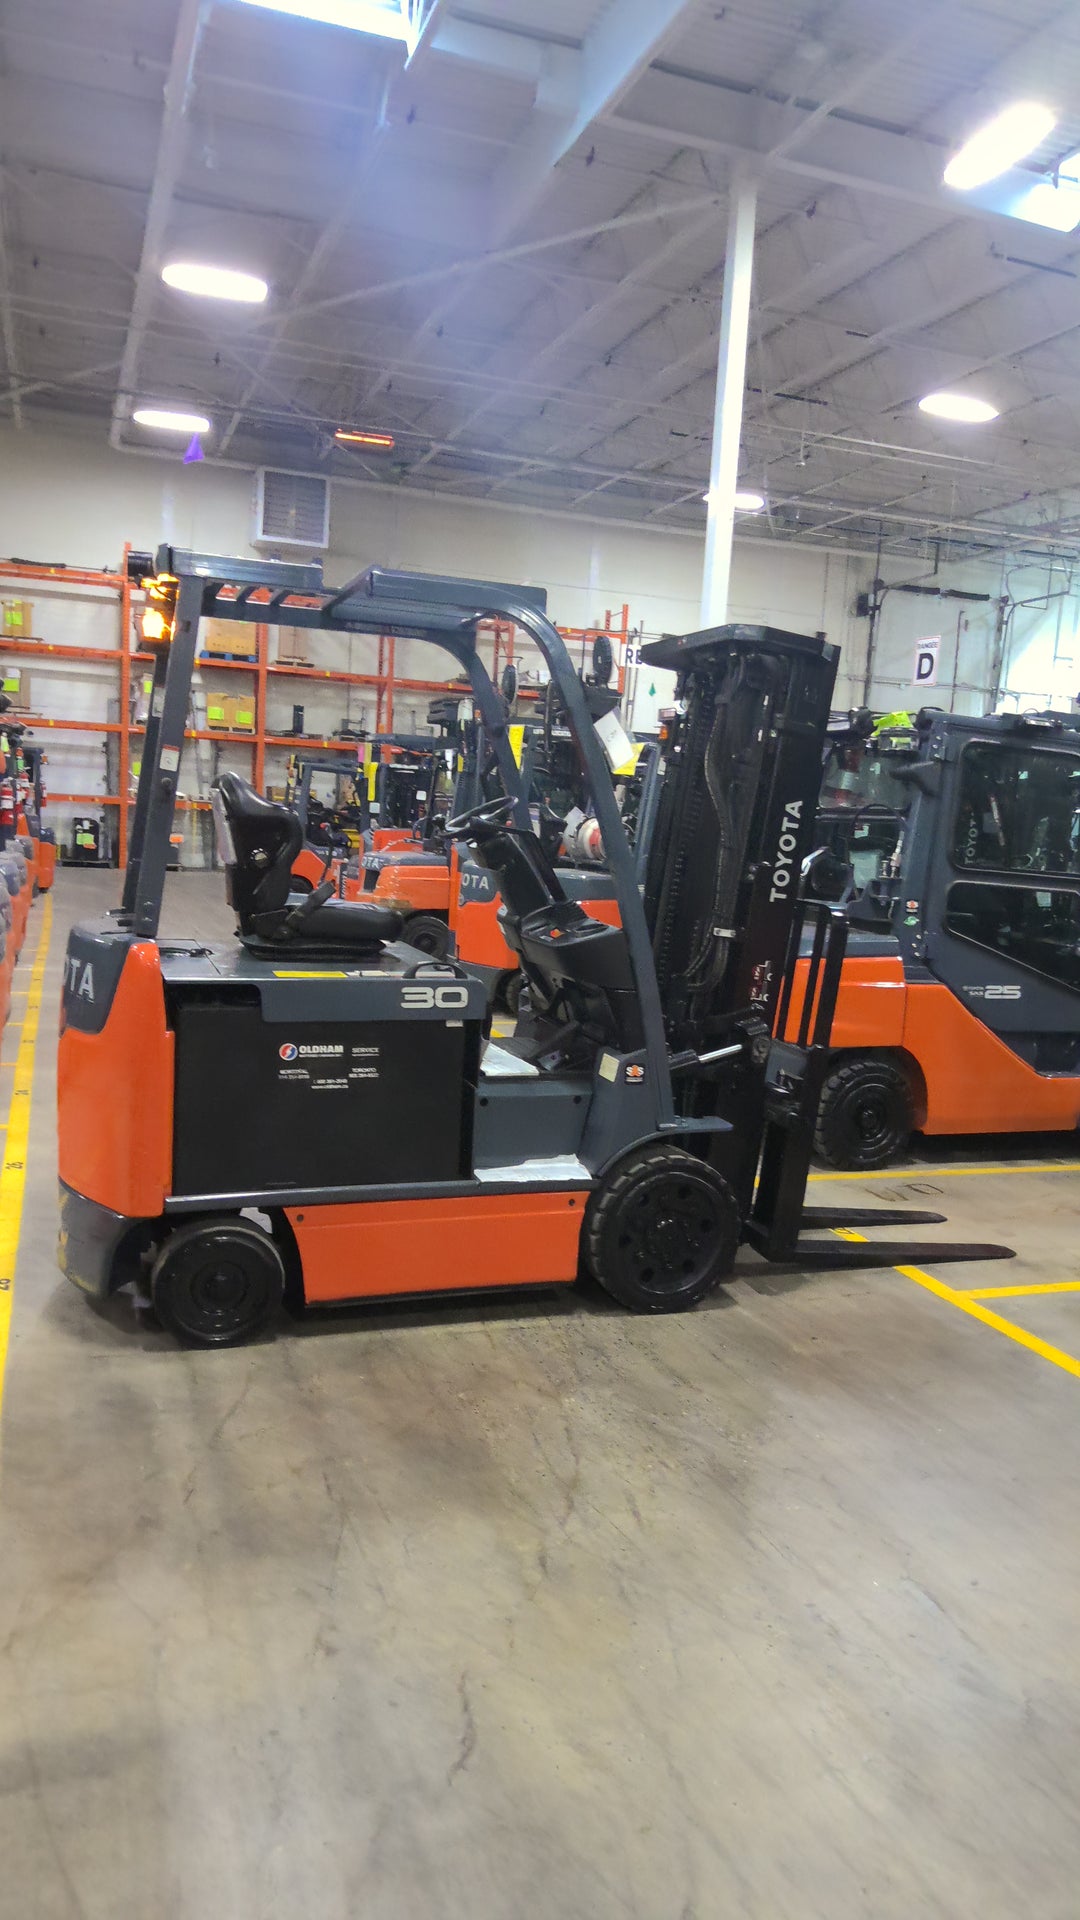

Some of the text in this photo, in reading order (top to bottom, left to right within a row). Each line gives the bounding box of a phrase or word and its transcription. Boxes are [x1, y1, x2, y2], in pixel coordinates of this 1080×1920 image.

[916, 652, 934, 680] D
[769, 800, 803, 902] TOYOTA
[461, 873, 489, 890] OTA
[400, 986, 469, 1009] 30
[984, 985, 1021, 999] 25
[299, 1045, 344, 1054] OLDHAM
